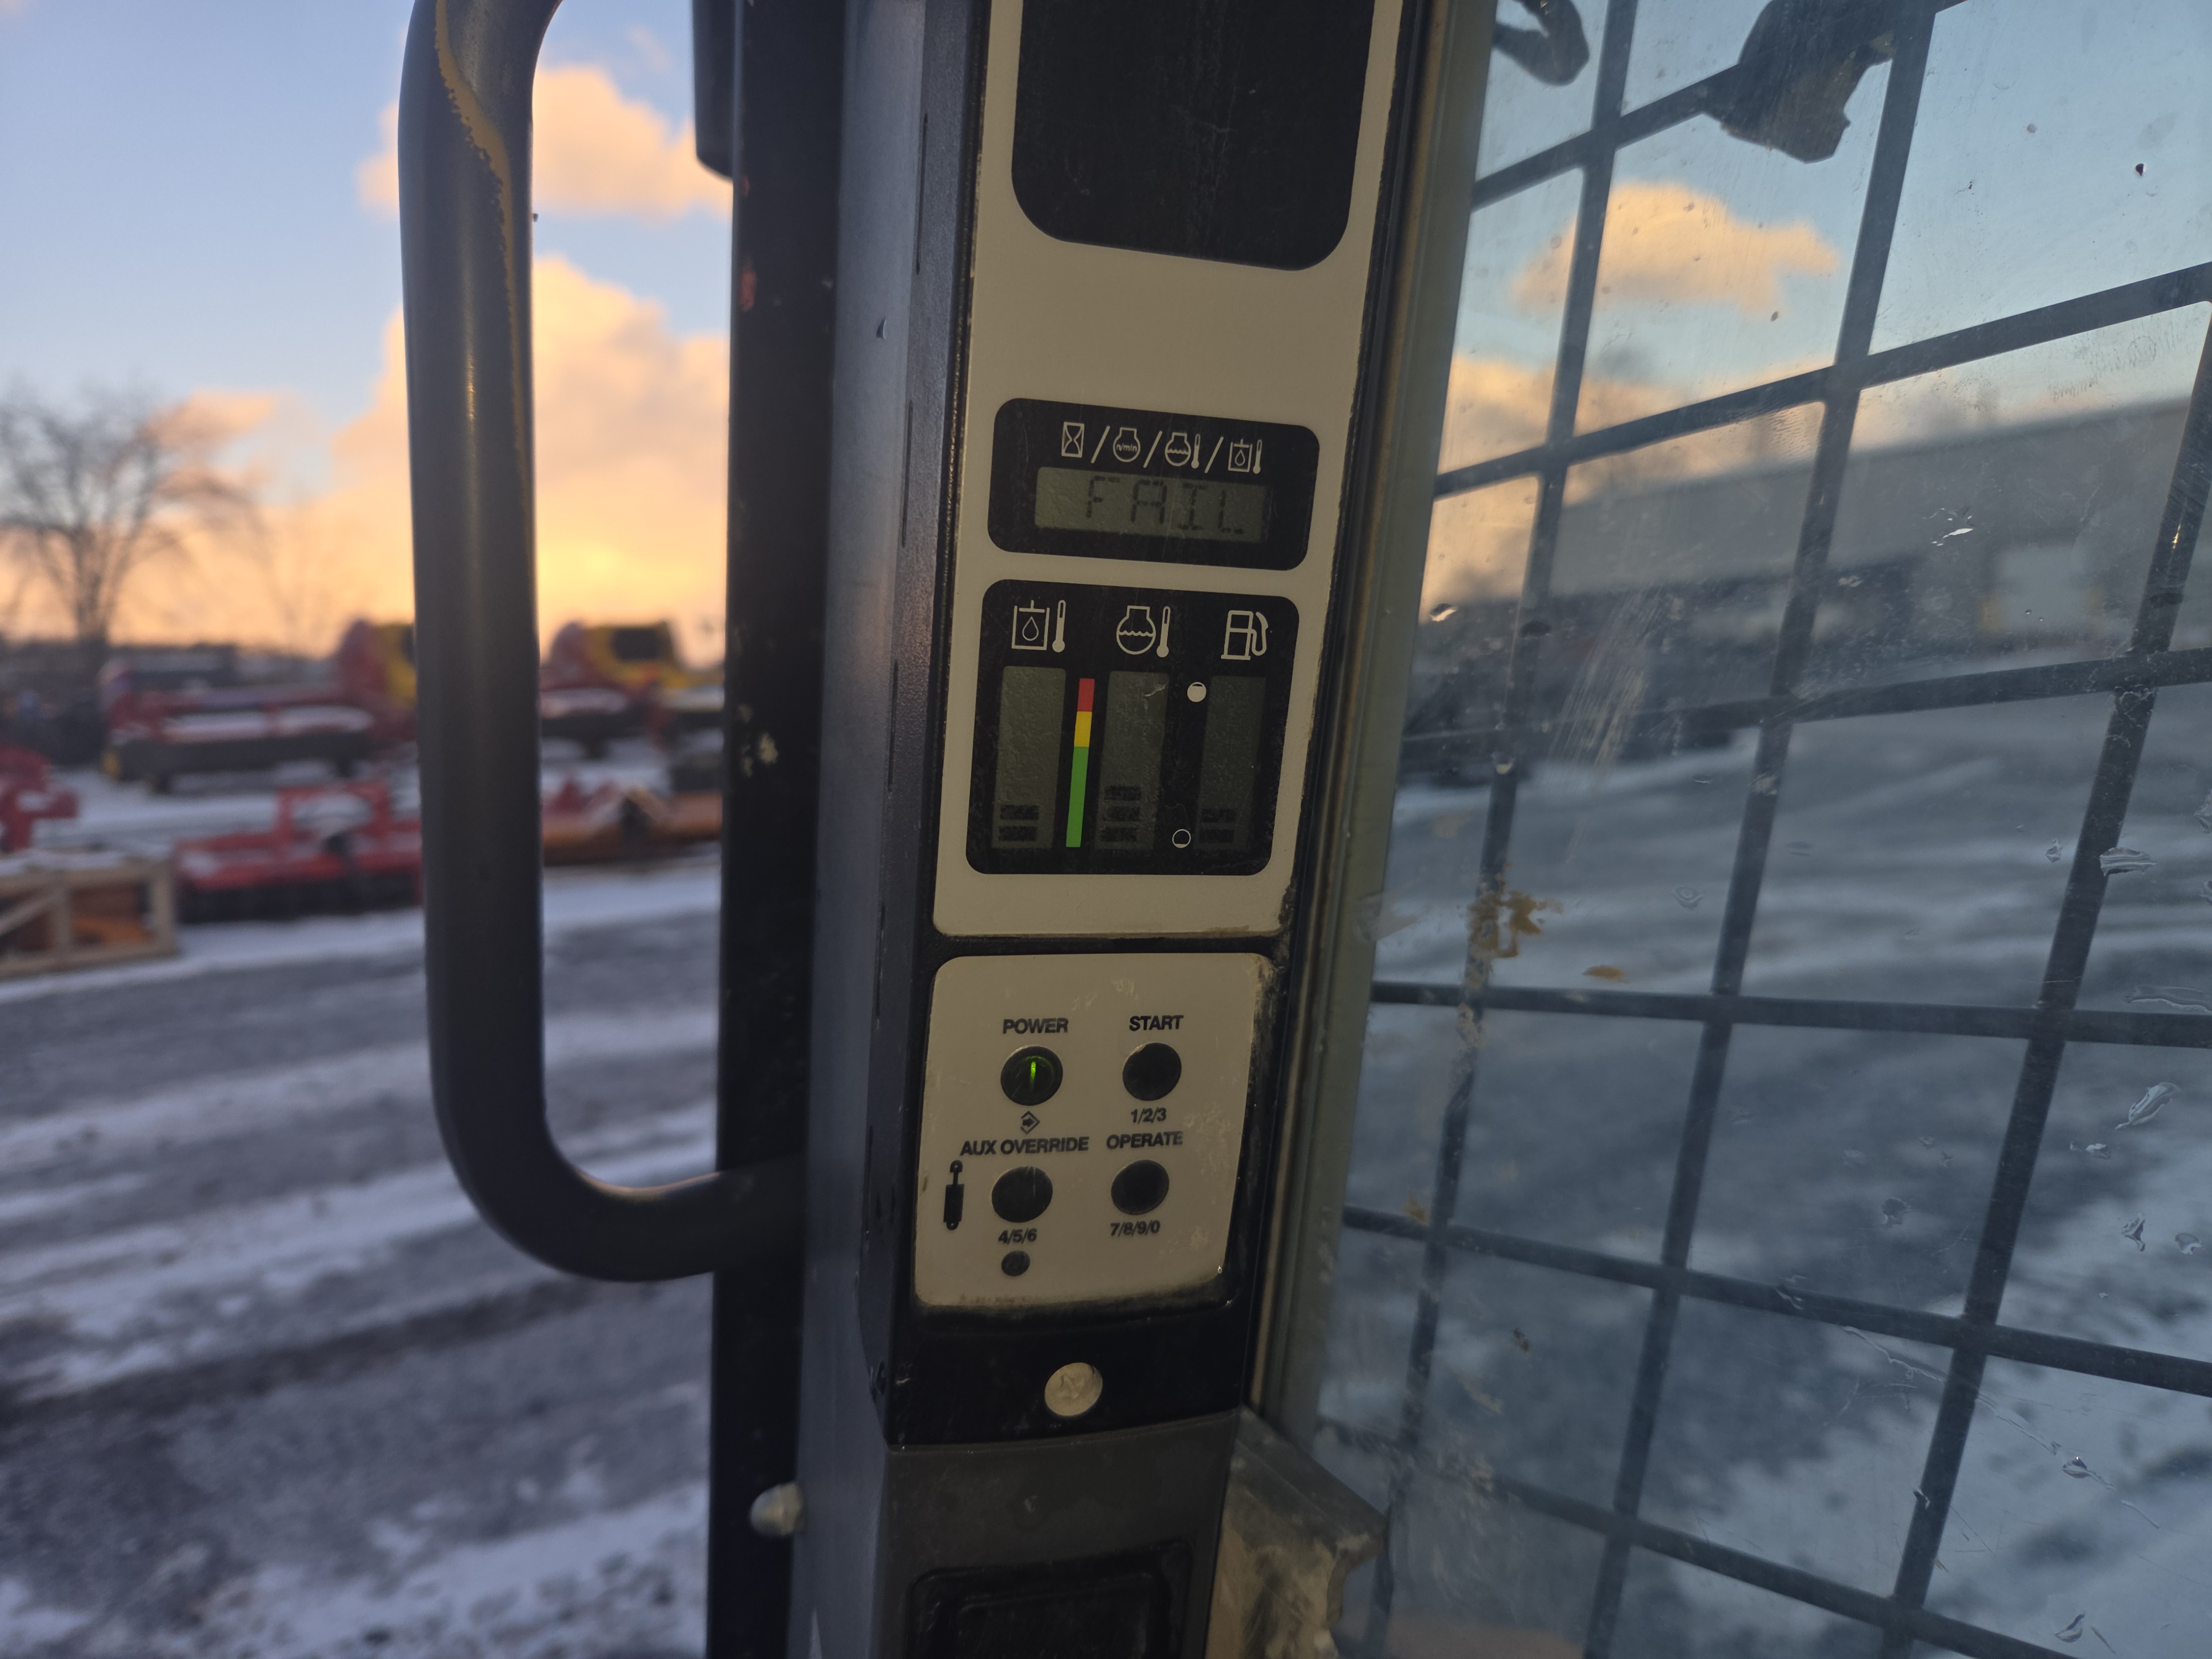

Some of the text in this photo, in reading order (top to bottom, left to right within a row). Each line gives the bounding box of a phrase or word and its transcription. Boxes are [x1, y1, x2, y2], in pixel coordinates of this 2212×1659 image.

[1086, 476, 1244, 534] FAIL
[1003, 1018, 1068, 1034] POWER
[1129, 1015, 1183, 1031] START
[1130, 1108, 1166, 1123] 1/2/3
[960, 1136, 1089, 1156] AUX OVERRIDE
[1106, 1131, 1183, 1149] OPERATE
[998, 1228, 1037, 1243] 4/5/6
[1110, 1220, 1160, 1237] 7/8/9/0
